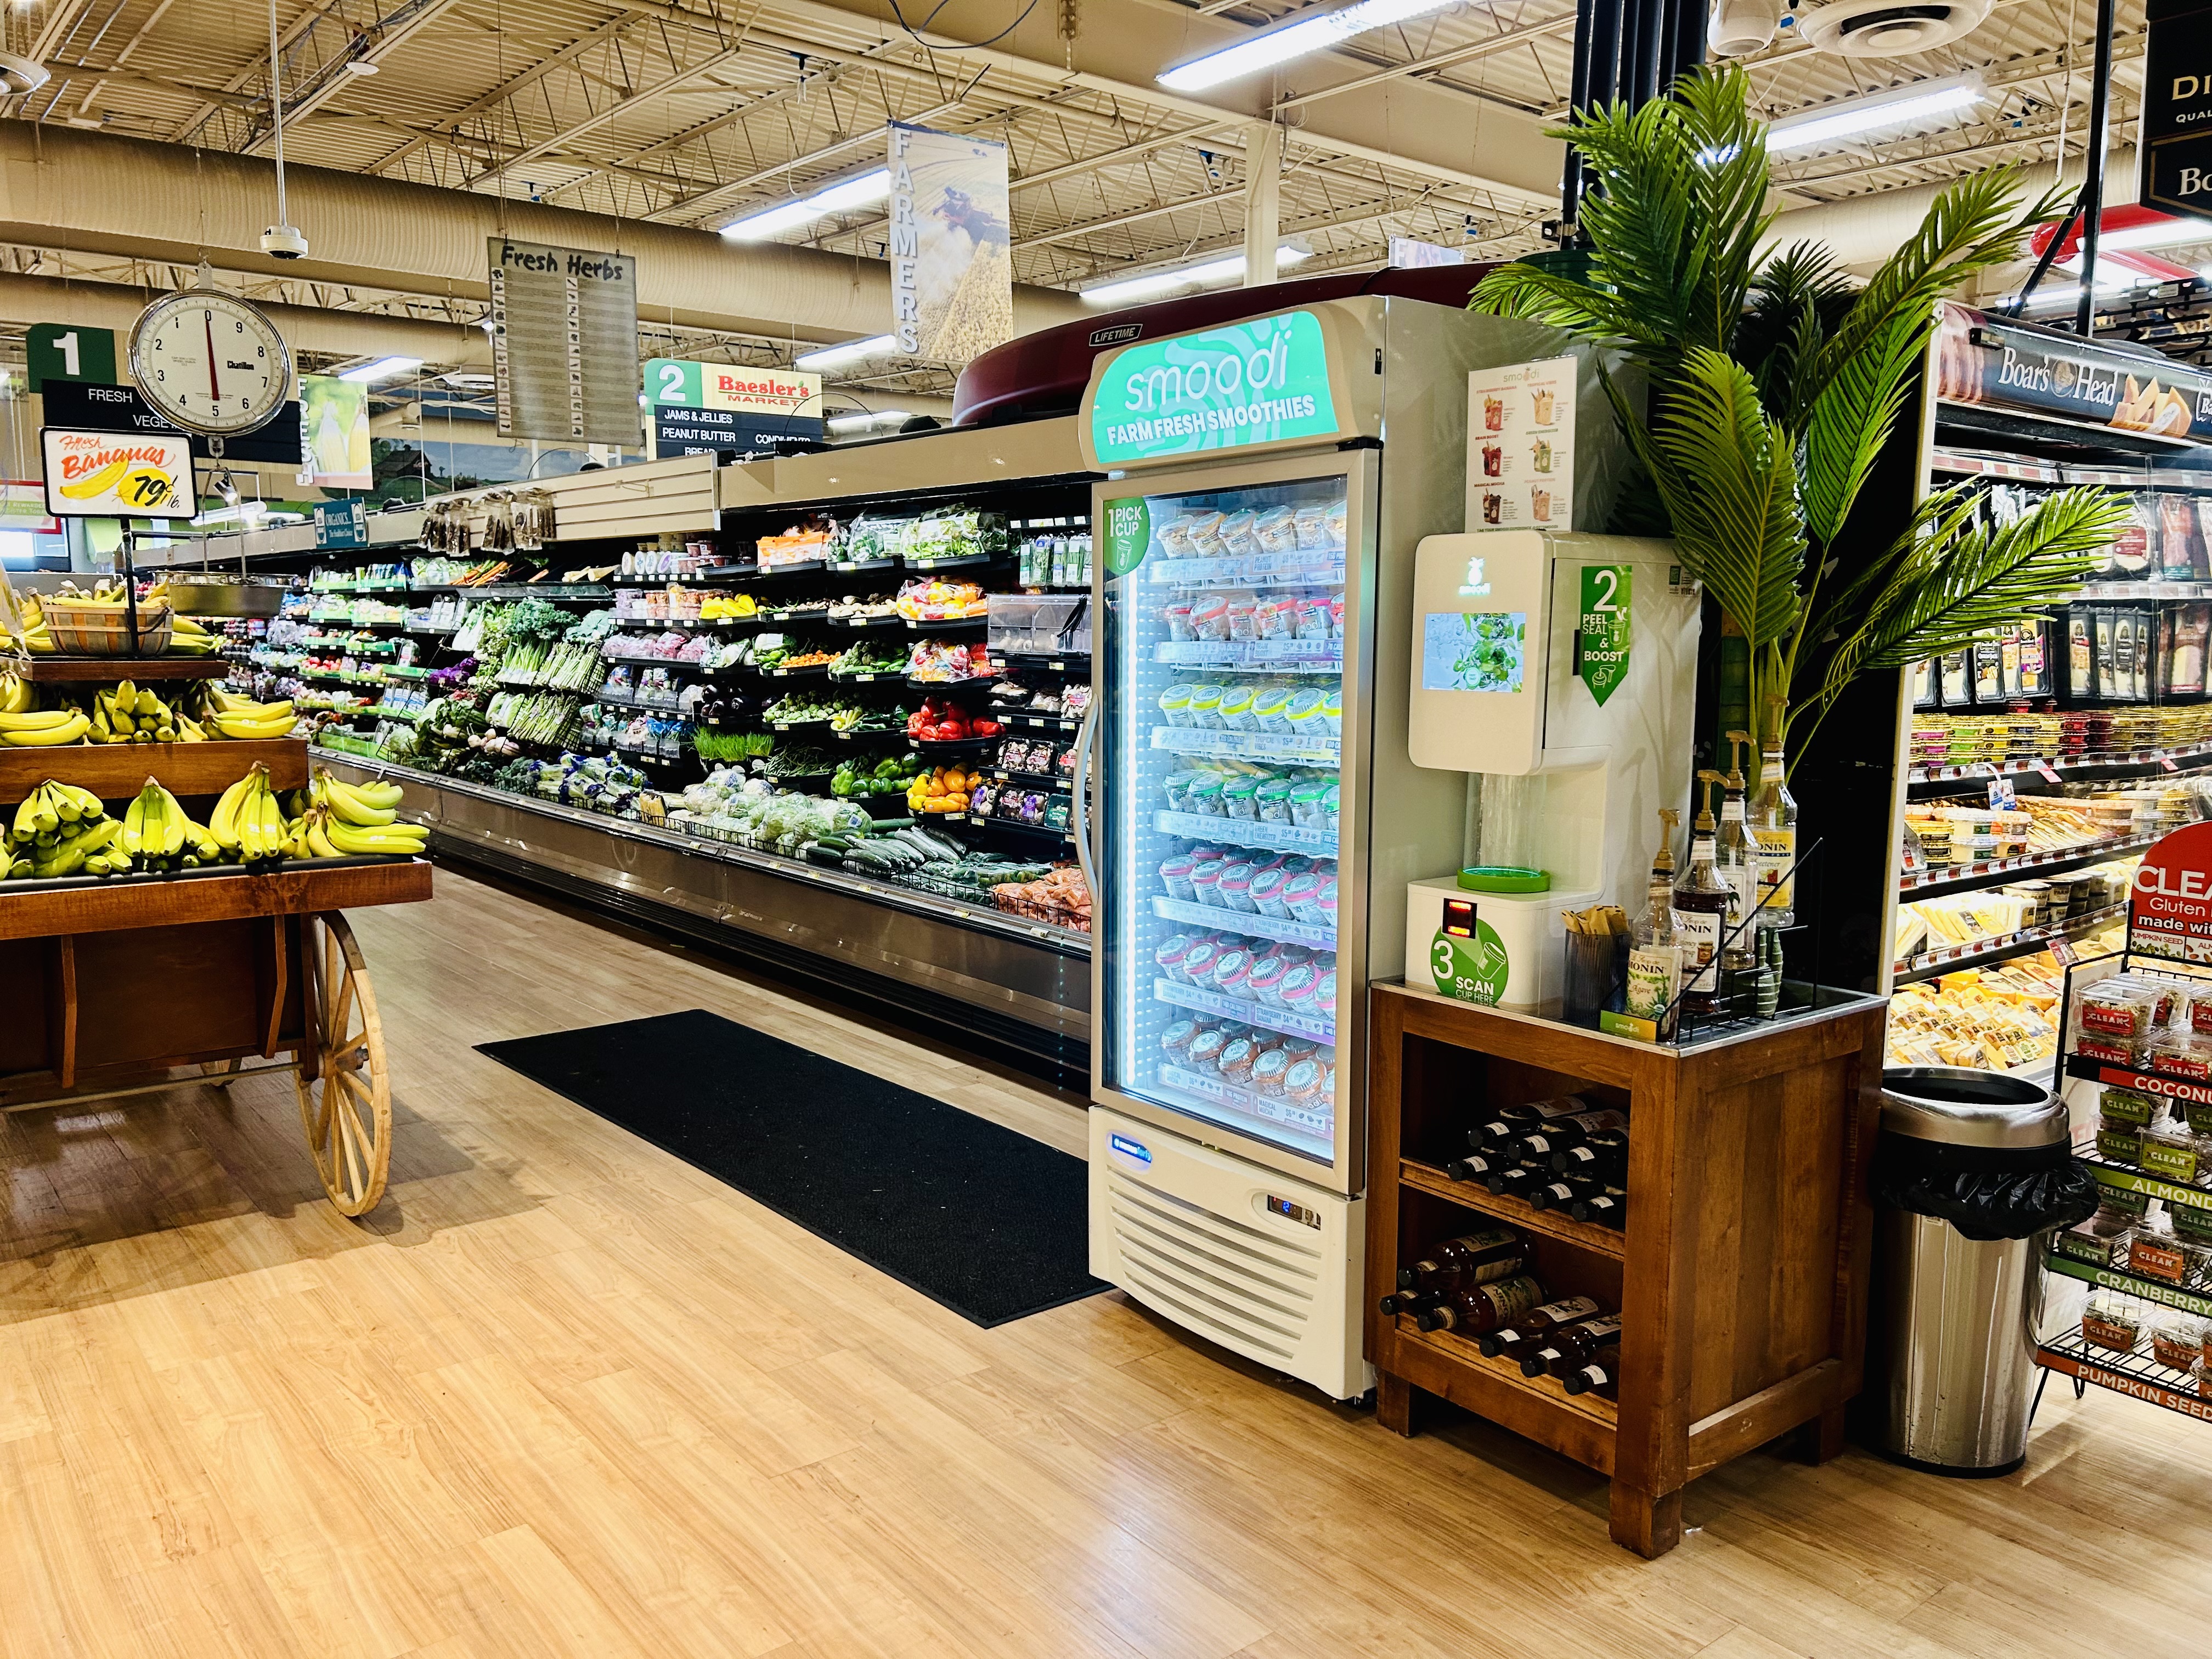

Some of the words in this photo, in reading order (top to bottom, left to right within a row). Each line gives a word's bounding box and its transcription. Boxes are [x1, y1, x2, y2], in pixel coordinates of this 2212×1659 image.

[894, 127, 919, 354] FARMERS
[500, 245, 558, 273] Fresh
[567, 254, 624, 281] Herbs
[205, 310, 212, 321] 0
[236, 321, 243, 333] 9
[1094, 326, 1136, 343] LIFETIME
[155, 338, 163, 351] 2
[257, 346, 264, 358] 8
[53, 331, 82, 376] 1
[227, 360, 255, 371] Chatillon
[1125, 329, 1293, 411] smoodi
[157, 370, 165, 382] 3
[261, 377, 268, 388] 7
[658, 364, 686, 402] 2
[1997, 346, 2052, 392] Boar's
[2072, 363, 2119, 407] Head
[717, 375, 810, 398] Baesler's
[88, 388, 133, 403] FRESH
[179, 394, 187, 406] 4
[242, 398, 249, 409] 6
[727, 394, 800, 407] MARKET
[212, 405, 219, 417] 5
[664, 409, 690, 421] JAMS
[691, 411, 698, 422] &
[698, 411, 733, 424] JELLIES
[1107, 421, 1154, 446] FARM
[1154, 413, 1206, 439] FRESH
[1206, 393, 1316, 431] SMOOTHIES
[297, 377, 315, 486] FRESH
[662, 427, 699, 440] PEANUT
[700, 430, 736, 442] BUTTER
[59, 435, 106, 451] Fresh
[61, 445, 177, 480] Bananas
[1108, 509, 1115, 538] 1
[1115, 505, 1143, 522] PICK
[1115, 521, 1140, 537] CUP
[1593, 569, 1618, 612] 2
[1582, 613, 1608, 625] PEEL
[1582, 623, 1608, 635] SEAL
[1599, 637, 1609, 648] &
[1584, 650, 1624, 662] BOOST
[2133, 865, 2212, 900] CLE
[2149, 896, 2205, 917] Gluten
[2138, 915, 2184, 931] made
[2163, 936, 2183, 945] SEED
[1432, 939, 1454, 979] 3
[1455, 976, 1494, 995] SCAN
[1455, 989, 1472, 1000] CUP
[1474, 992, 1494, 1005] HERE
[2107, 1099, 2140, 1113] CLEAN
[2103, 1138, 2136, 1151] CLEAN
[2151, 1152, 2186, 1166] CLEAN
[2103, 1187, 2136, 1202] CLEAN
[2066, 1245, 2099, 1262] CLEAN
[2138, 1251, 2173, 1267] CLEAN
[2089, 1325, 2123, 1341] CLEAN
[2077, 1365, 2160, 1403] PUMPKIN
